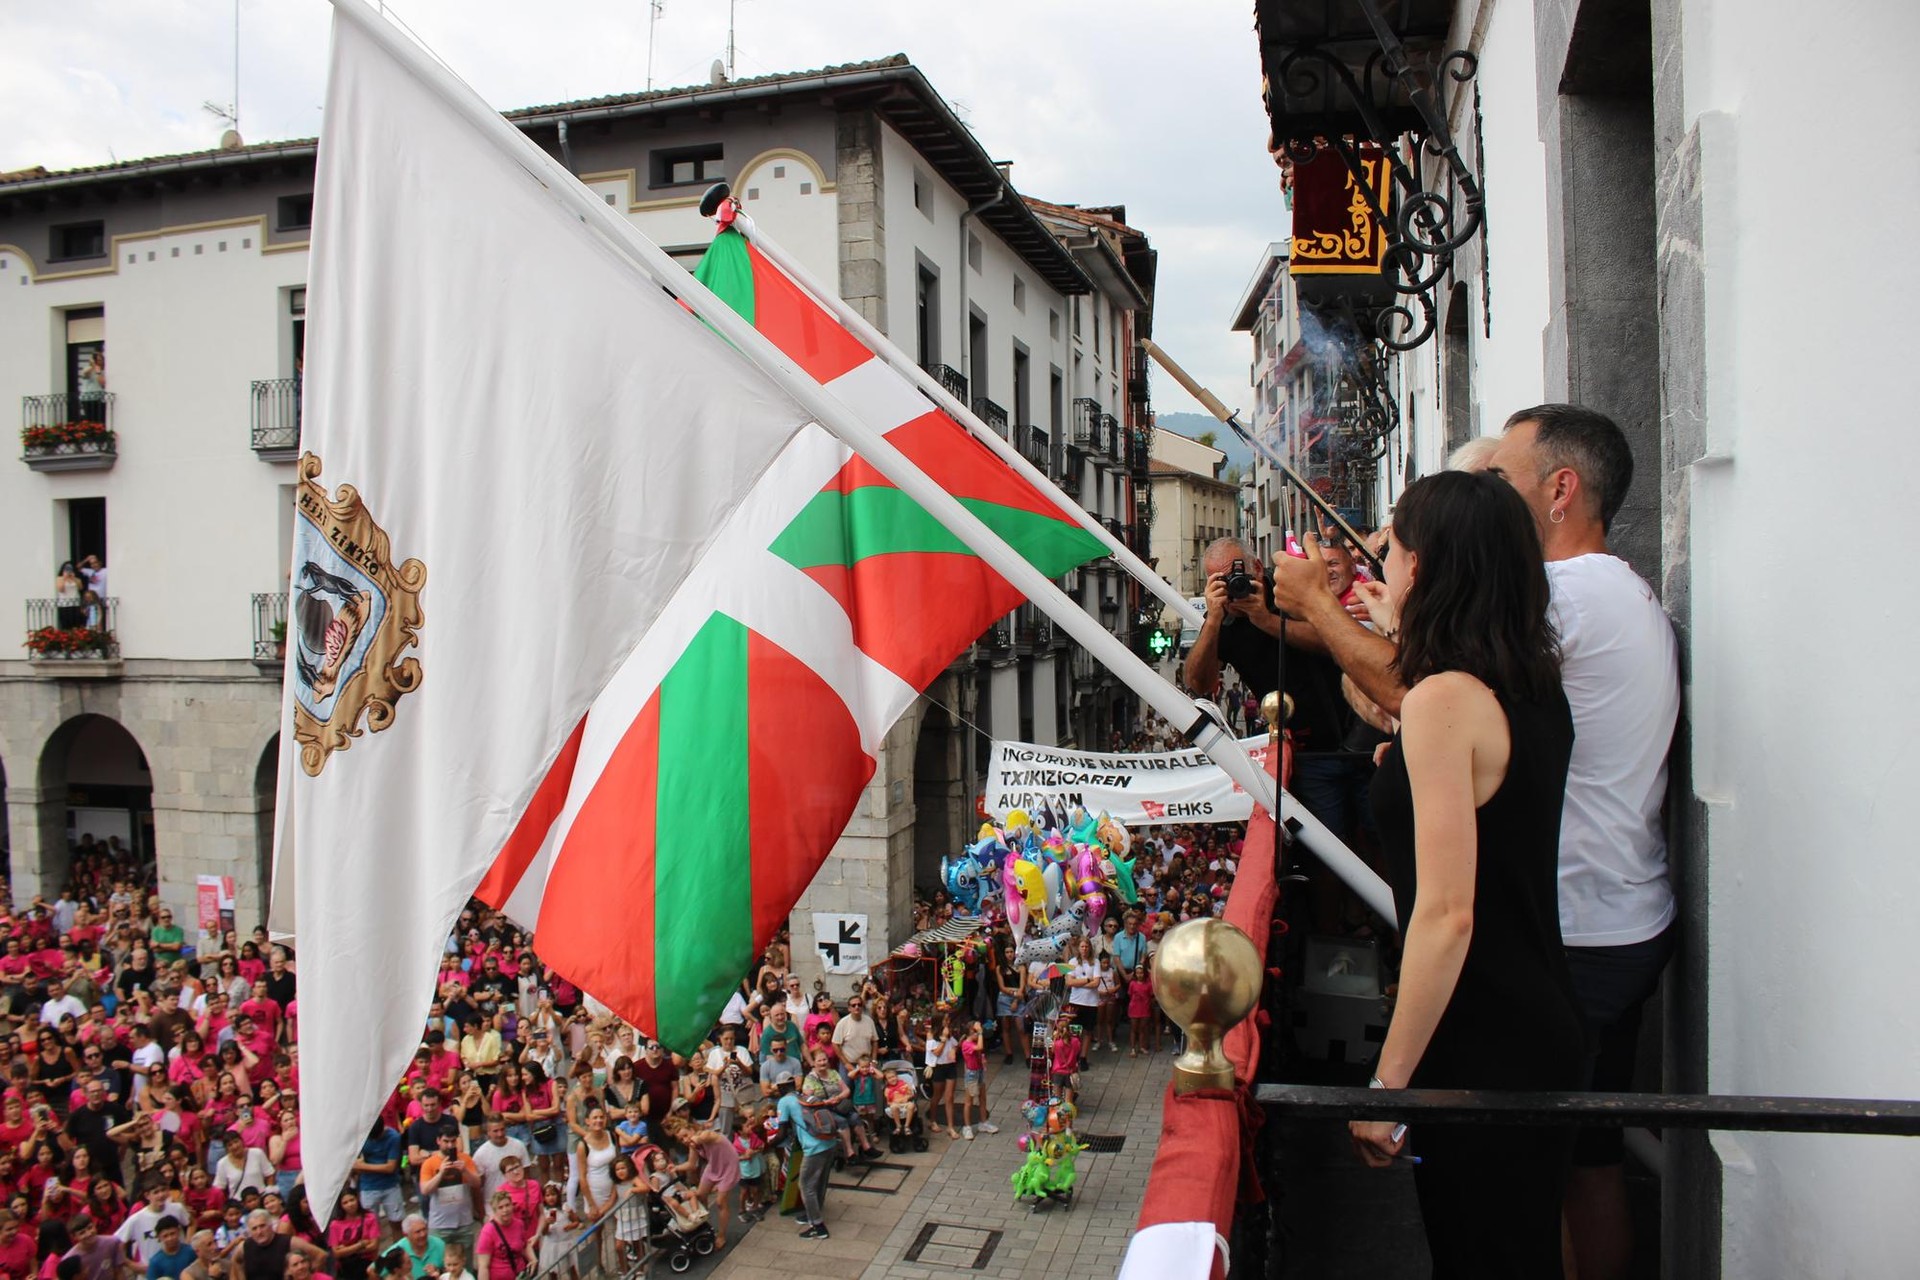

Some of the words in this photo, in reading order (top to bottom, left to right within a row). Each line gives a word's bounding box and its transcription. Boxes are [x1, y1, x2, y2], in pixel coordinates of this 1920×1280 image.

[1003, 747, 1097, 769] INGURUNE
[1001, 770, 1132, 788] TXIKIZIOAREN
[1167, 802, 1213, 816] EHKS
